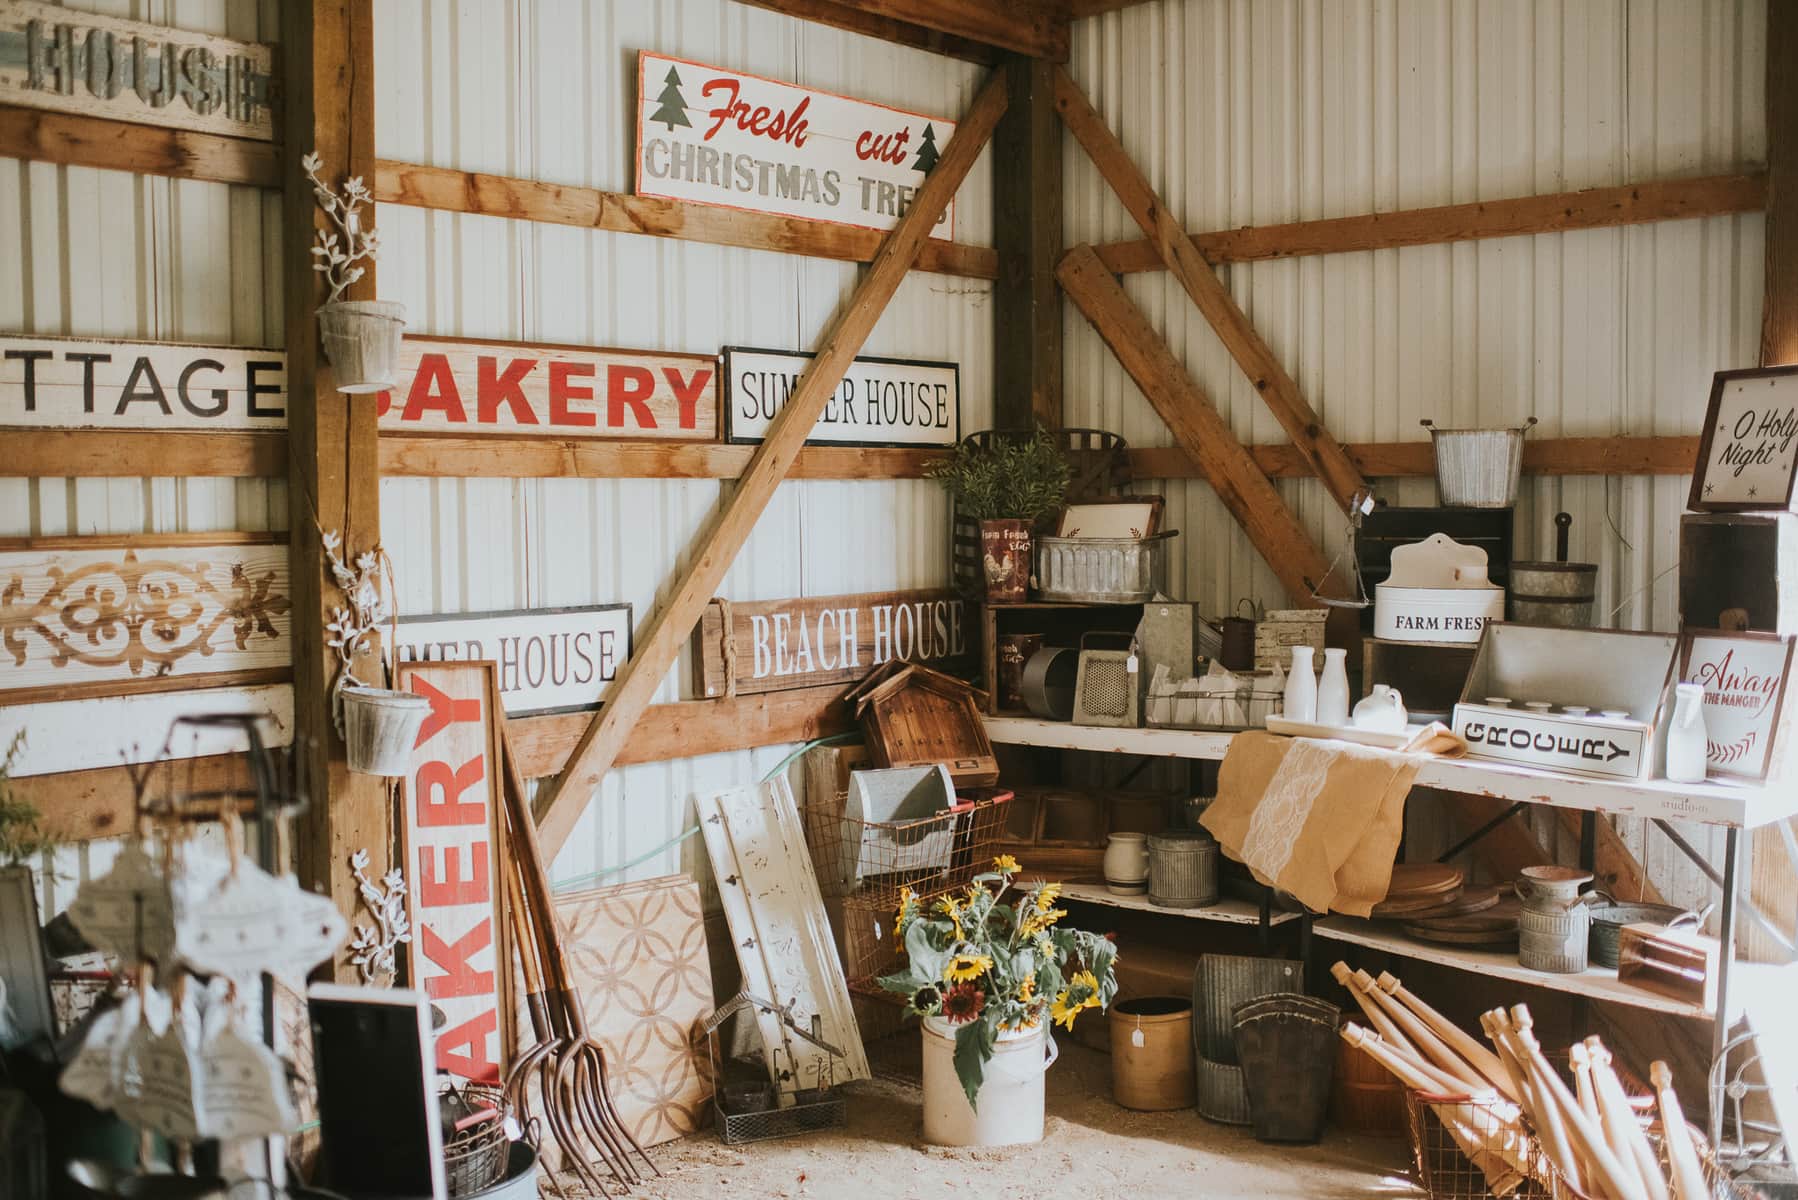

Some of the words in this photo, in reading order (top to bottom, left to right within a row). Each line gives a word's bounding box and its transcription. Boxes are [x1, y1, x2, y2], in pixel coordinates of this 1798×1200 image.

[27, 18, 258, 123] HOUSE
[702, 78, 811, 148] Fresh
[855, 126, 909, 165] cut
[645, 137, 841, 206] CHRISTMAS
[857, 176, 947, 224] TRE
[378, 353, 713, 430] AKERY
[741, 371, 858, 424] SUMER
[864, 379, 949, 428] HOUSE
[1718, 440, 1776, 478] Night
[1734, 410, 1756, 440] O
[1756, 408, 1798, 454] Holy
[751, 608, 860, 679] BEACH
[872, 599, 966, 666] HOUSE
[1395, 615, 1439, 630] FARM
[499, 630, 617, 693] HOUSE
[1692, 648, 1780, 720] Away
[1704, 691, 1719, 705] THE
[1721, 693, 1760, 709] MANGER
[1464, 722, 1631, 762] GROCERY
[410, 671, 500, 1088] AKERY
